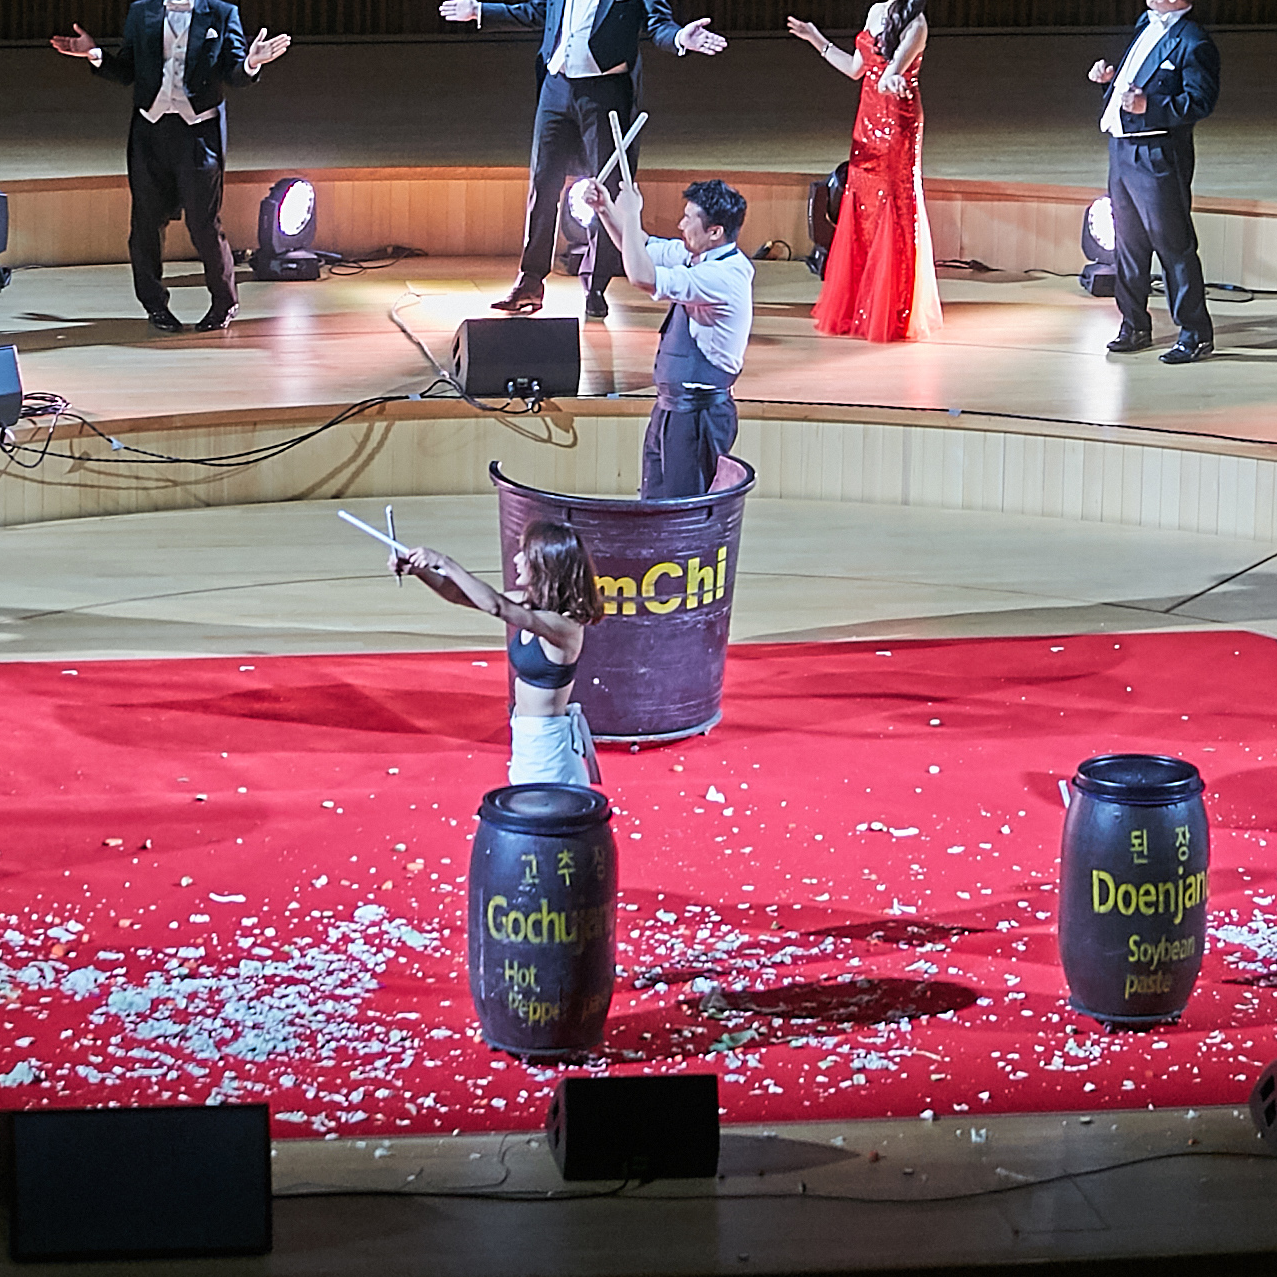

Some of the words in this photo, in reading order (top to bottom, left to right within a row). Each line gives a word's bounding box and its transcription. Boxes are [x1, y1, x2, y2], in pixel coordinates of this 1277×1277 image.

[593, 545, 727, 615] mChi
[1091, 865, 1210, 924] Doenjan
[1128, 934, 1195, 971] Soybean
[504, 959, 537, 988] Hot
[1124, 969, 1172, 999] paste
